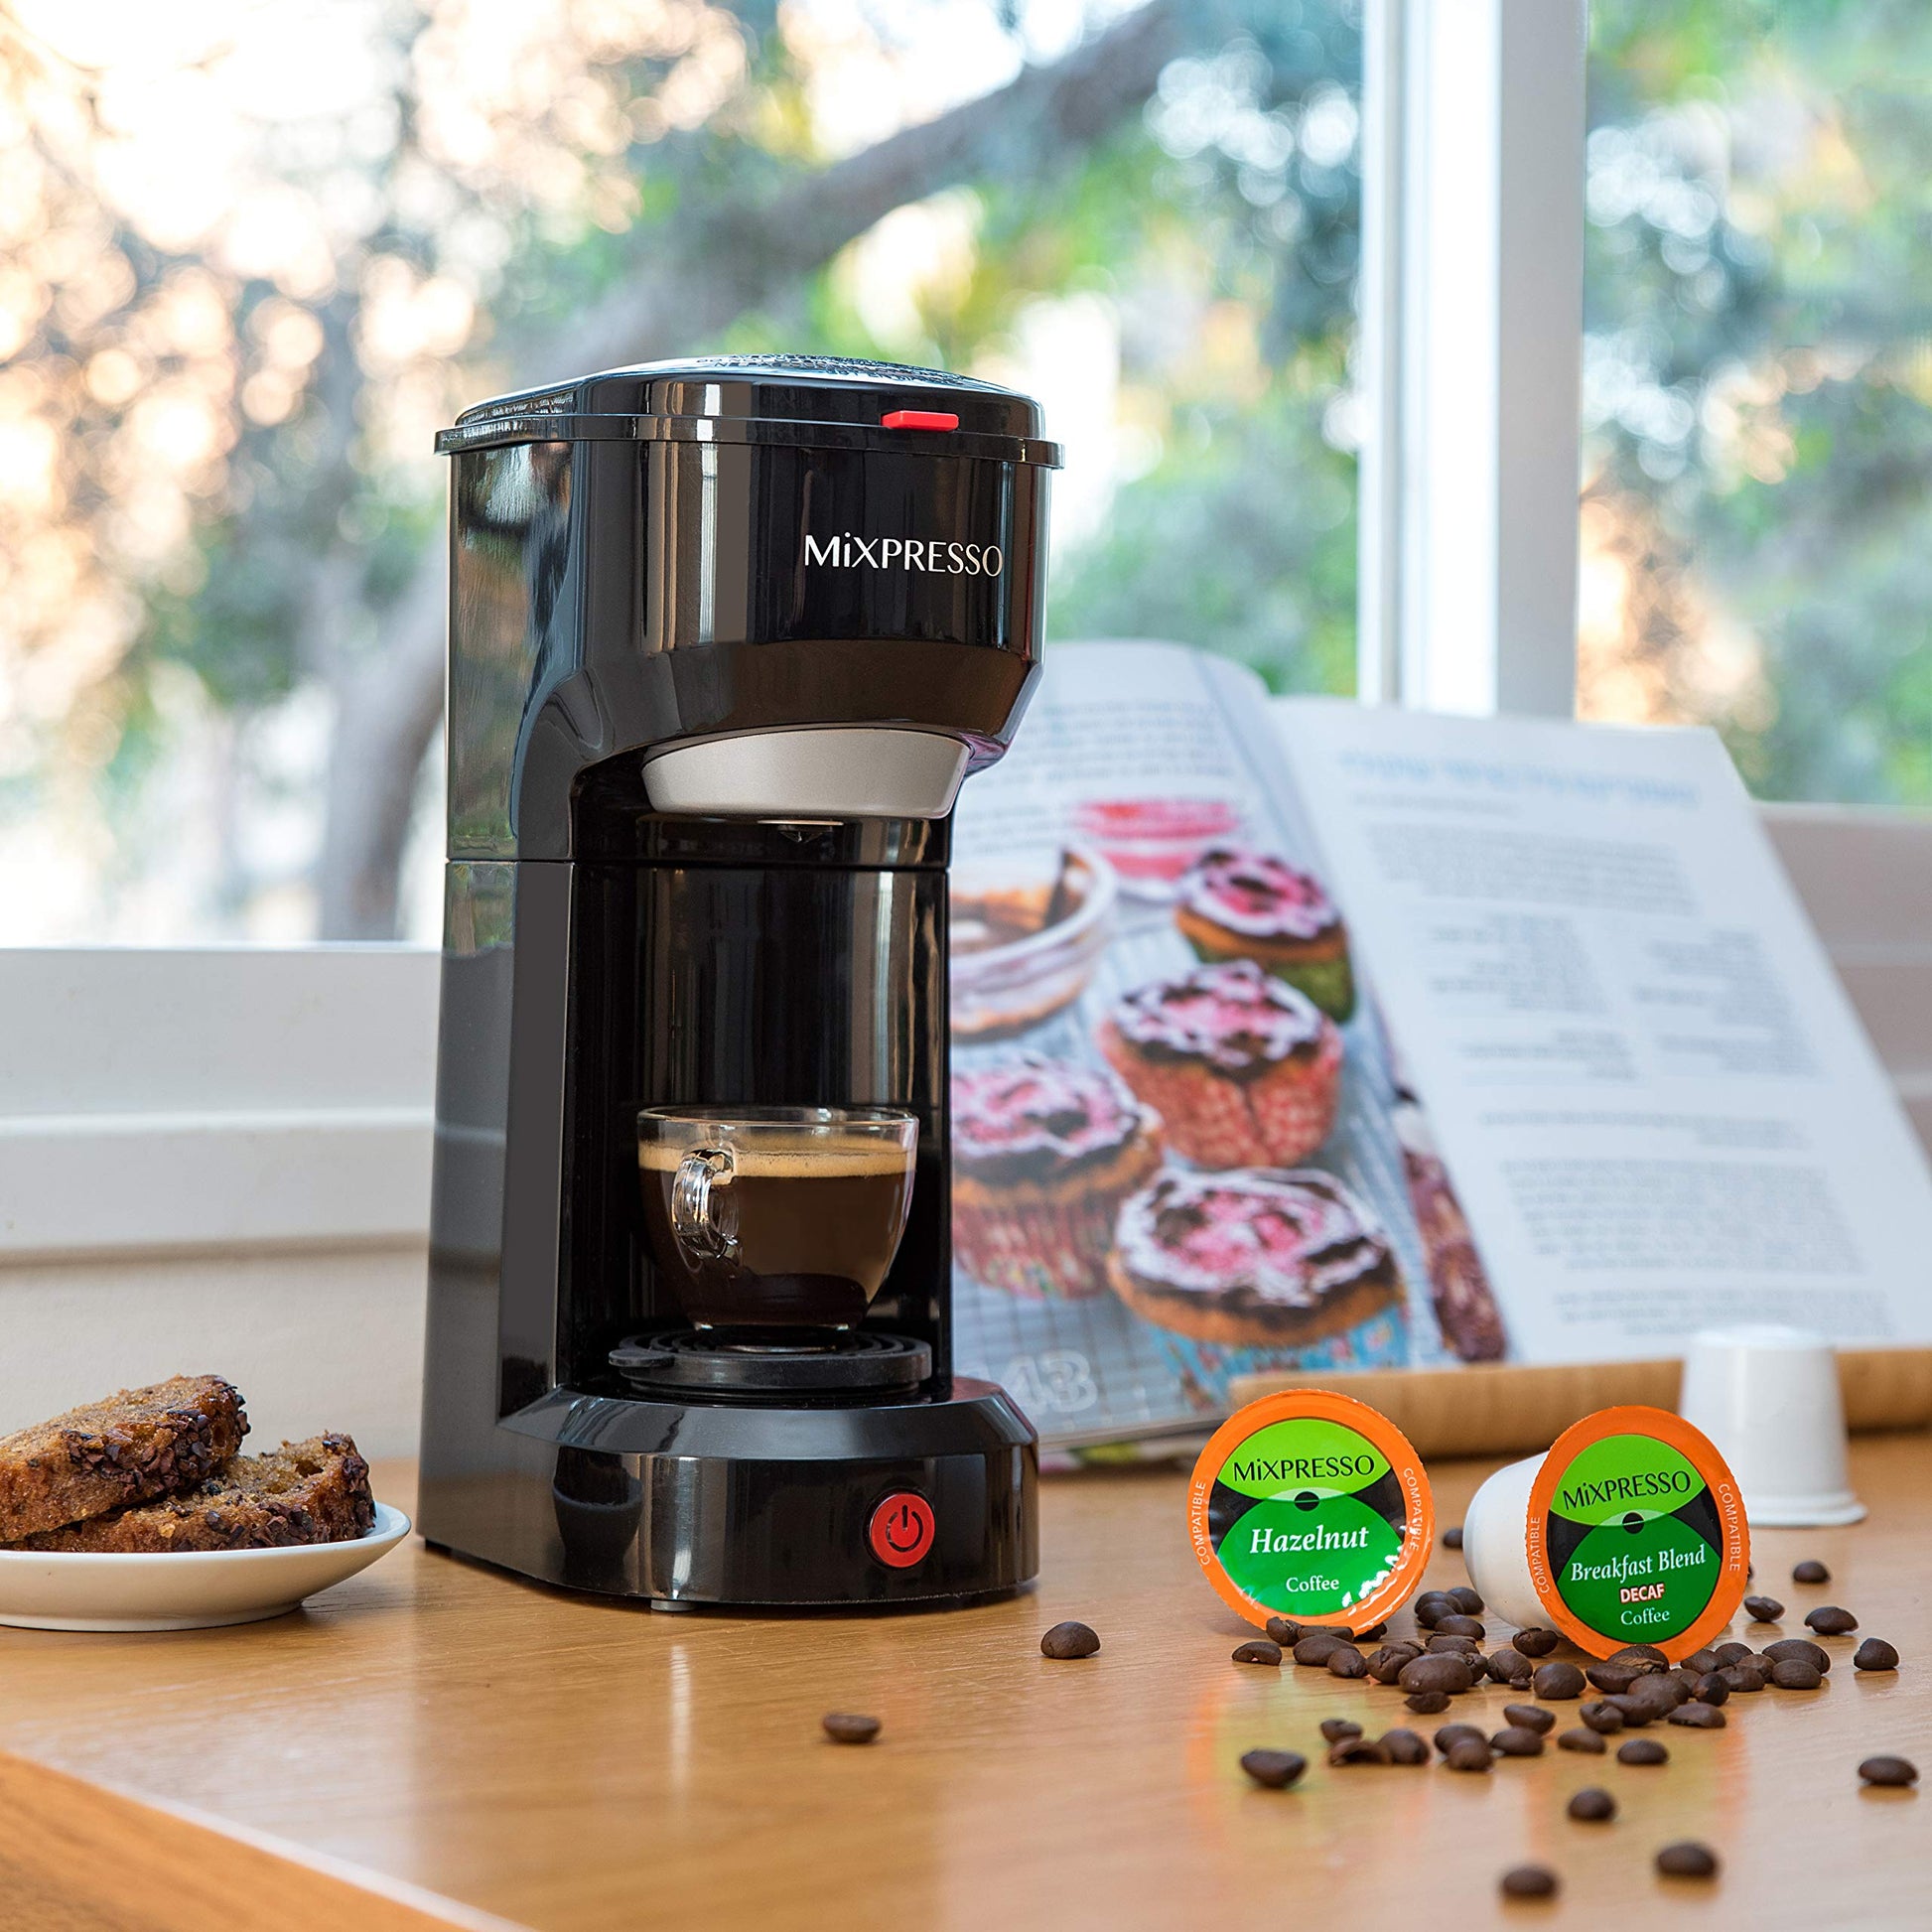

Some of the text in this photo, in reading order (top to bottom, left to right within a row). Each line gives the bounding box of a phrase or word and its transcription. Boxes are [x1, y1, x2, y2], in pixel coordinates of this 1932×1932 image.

[804, 531, 1004, 577] MiXPRESSO
[1233, 1454, 1375, 1482] MiXPRESSO
[1404, 1467, 1423, 1551] COMPATIBLE
[1563, 1470, 1692, 1511] MiXPRESSO
[1191, 1480, 1210, 1566] COMPATIBLE
[1249, 1524, 1370, 1554] Hazelnut
[1719, 1482, 1742, 1572] COMPATIBLE
[1530, 1517, 1550, 1593] COMPATIBLE
[1571, 1543, 1707, 1585] Breakfast Blend
[1286, 1576, 1340, 1592] Coffee
[1619, 1583, 1666, 1603] DECAF
[1620, 1606, 1671, 1626] Coffee
